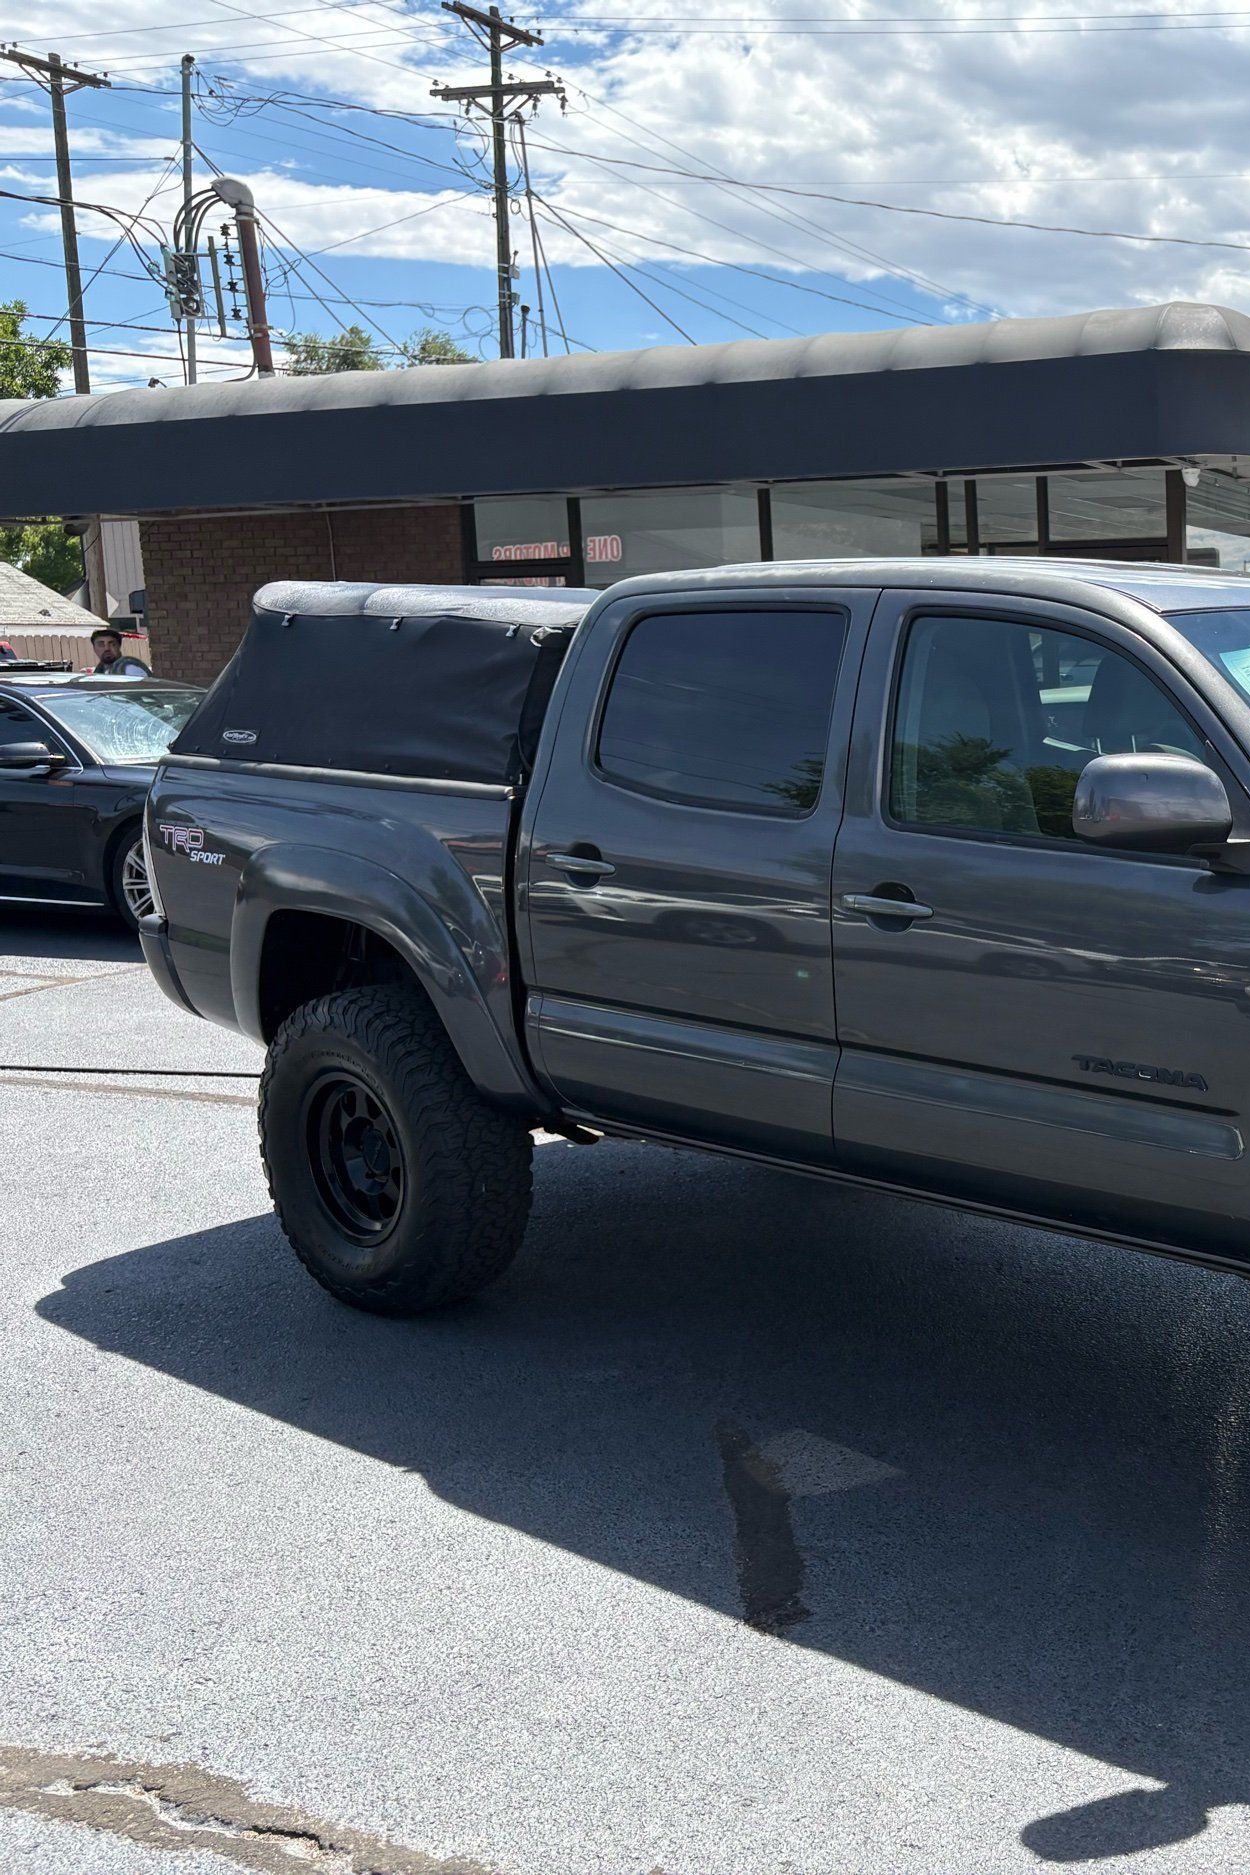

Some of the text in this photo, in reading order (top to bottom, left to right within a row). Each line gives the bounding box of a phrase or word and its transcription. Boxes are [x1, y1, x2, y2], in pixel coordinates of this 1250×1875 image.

[160, 824, 204, 853] TRD
[190, 851, 226, 865] SPORT
[1071, 1054, 1208, 1092] TACOMA
